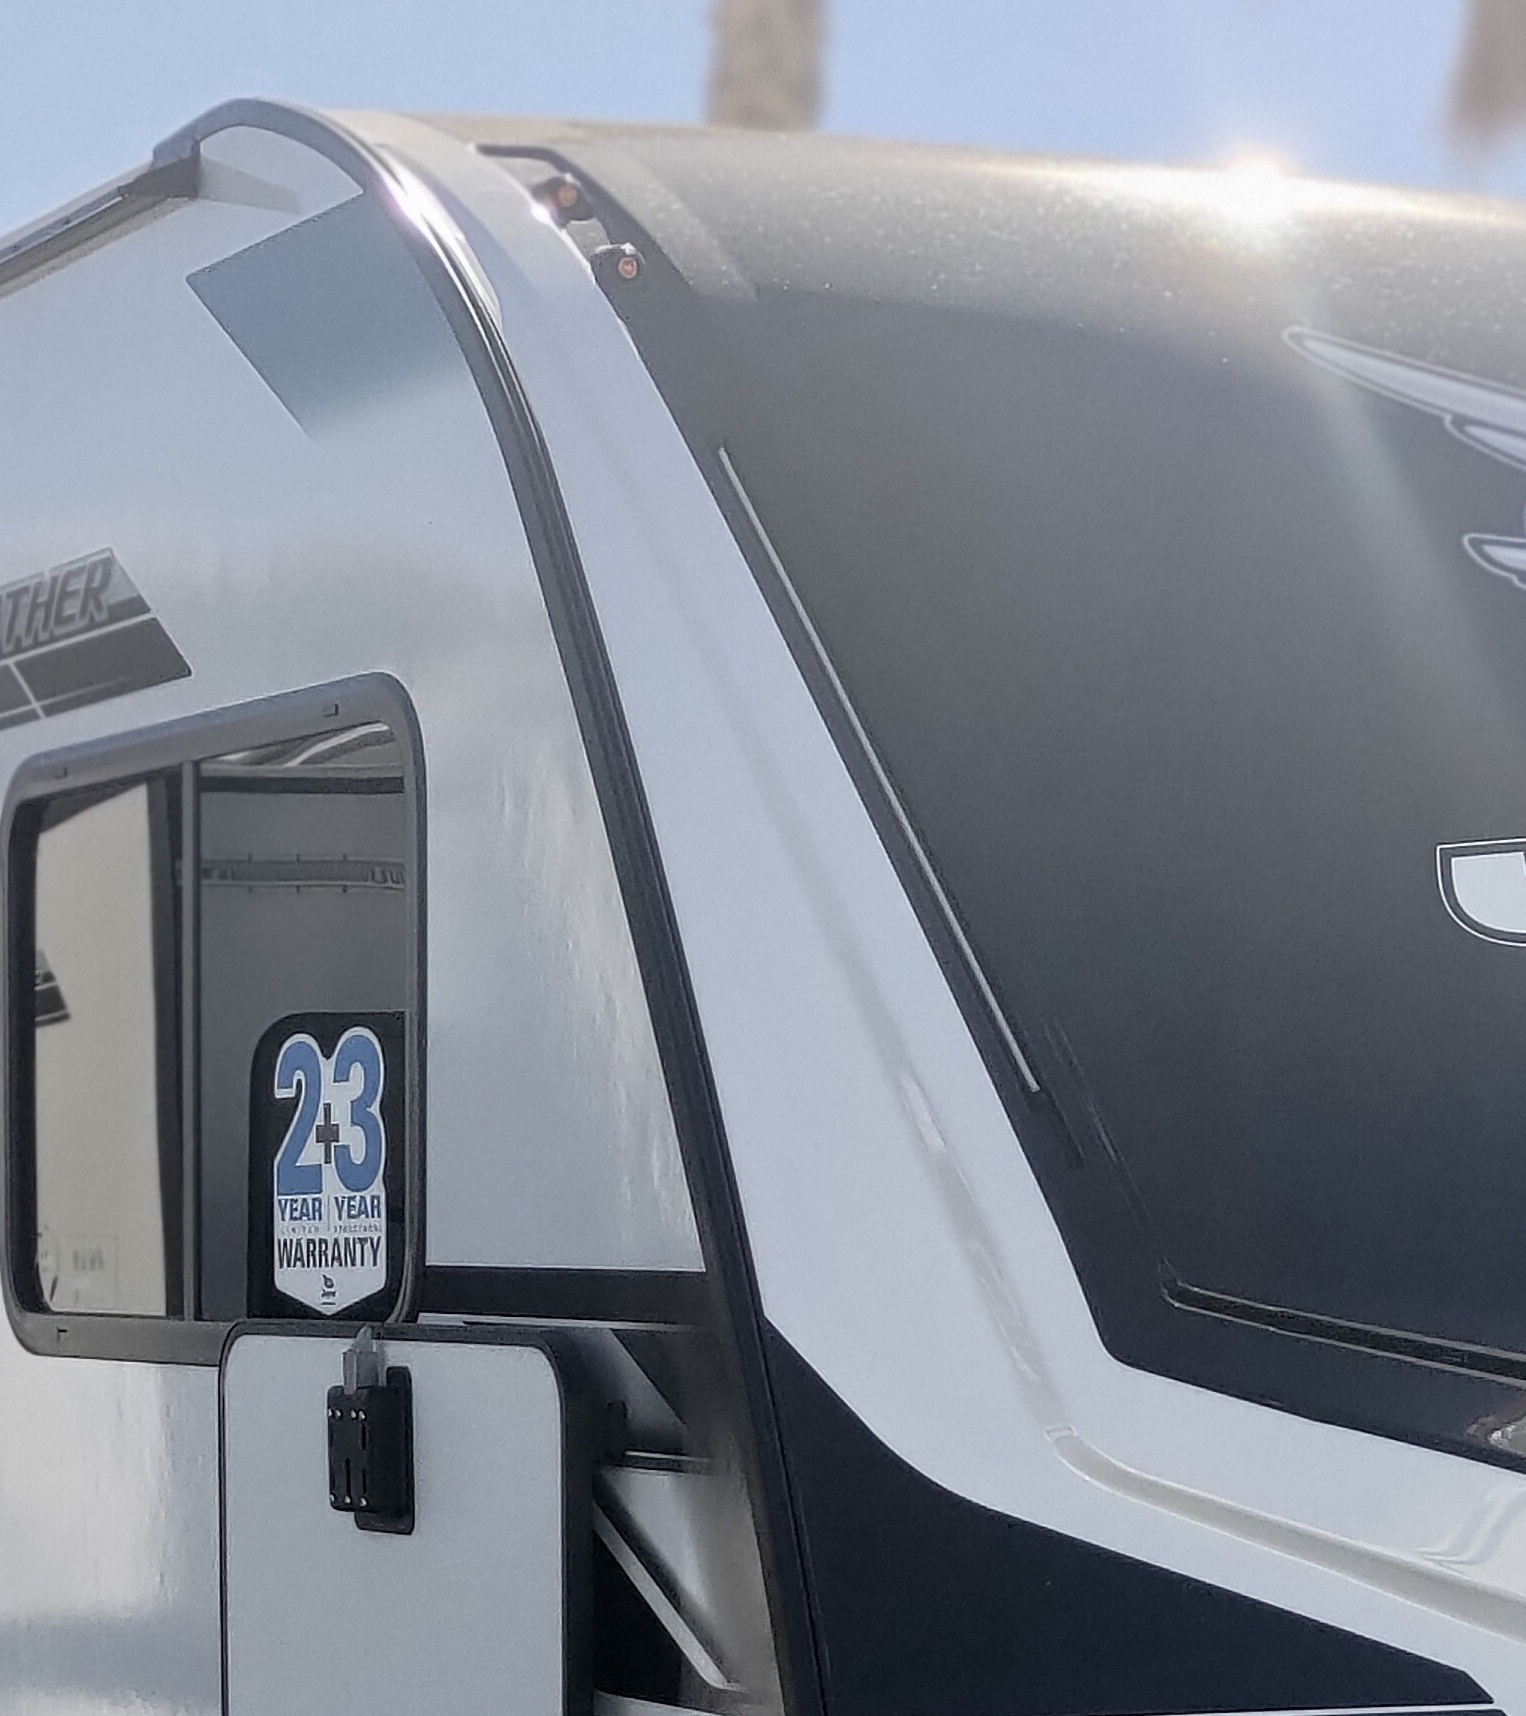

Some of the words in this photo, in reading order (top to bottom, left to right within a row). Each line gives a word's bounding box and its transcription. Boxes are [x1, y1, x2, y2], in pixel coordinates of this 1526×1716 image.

[278, 1198, 323, 1222] YEAR
[334, 1195, 381, 1221] YEAR
[277, 1235, 382, 1270] WARRANTY
